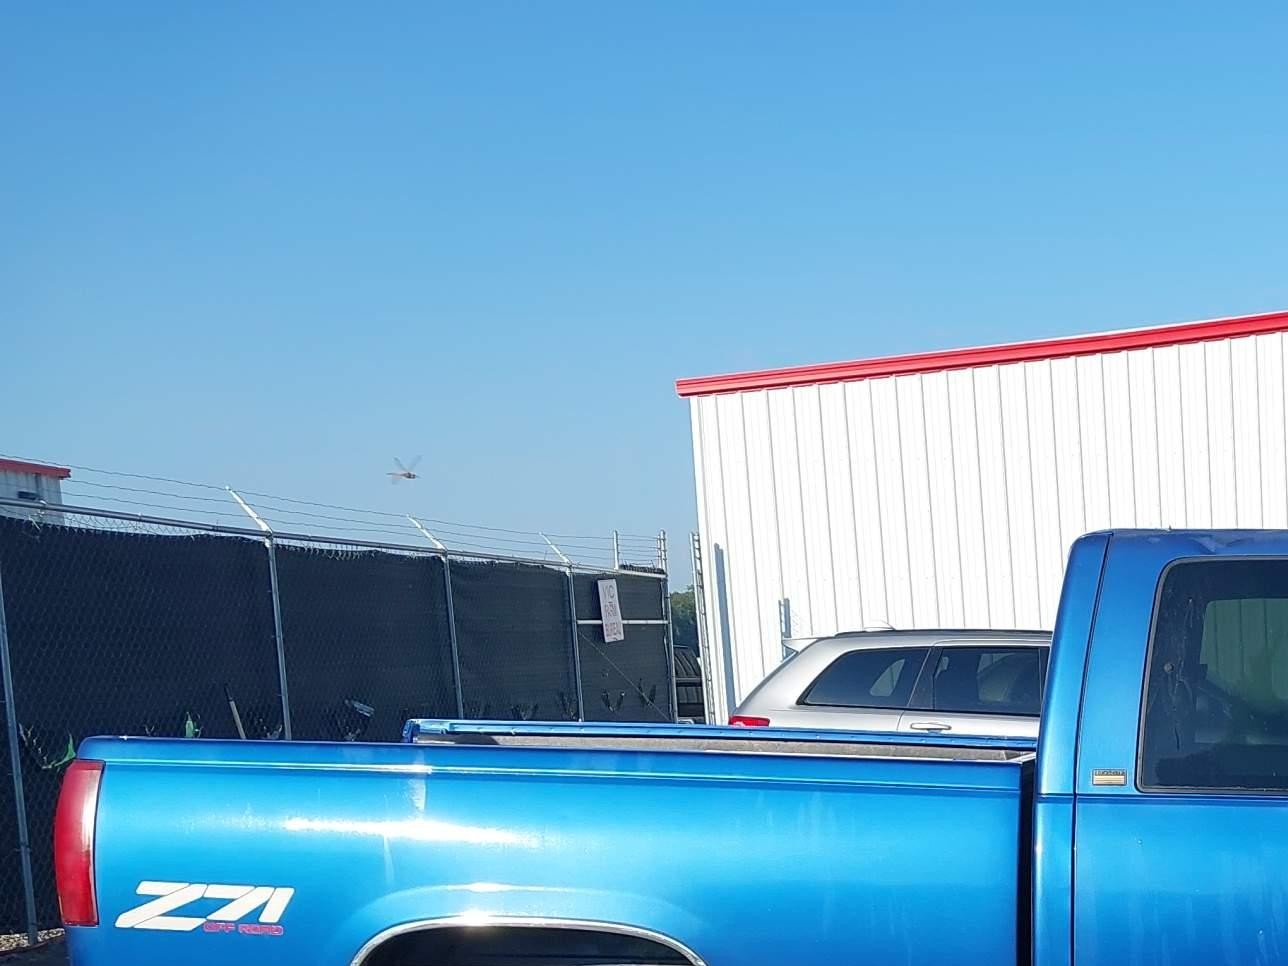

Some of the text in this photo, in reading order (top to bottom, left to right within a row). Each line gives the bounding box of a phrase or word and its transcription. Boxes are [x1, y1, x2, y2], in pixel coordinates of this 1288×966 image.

[114, 880, 295, 931] Z71
[203, 922, 284, 936] OFF ROAD
